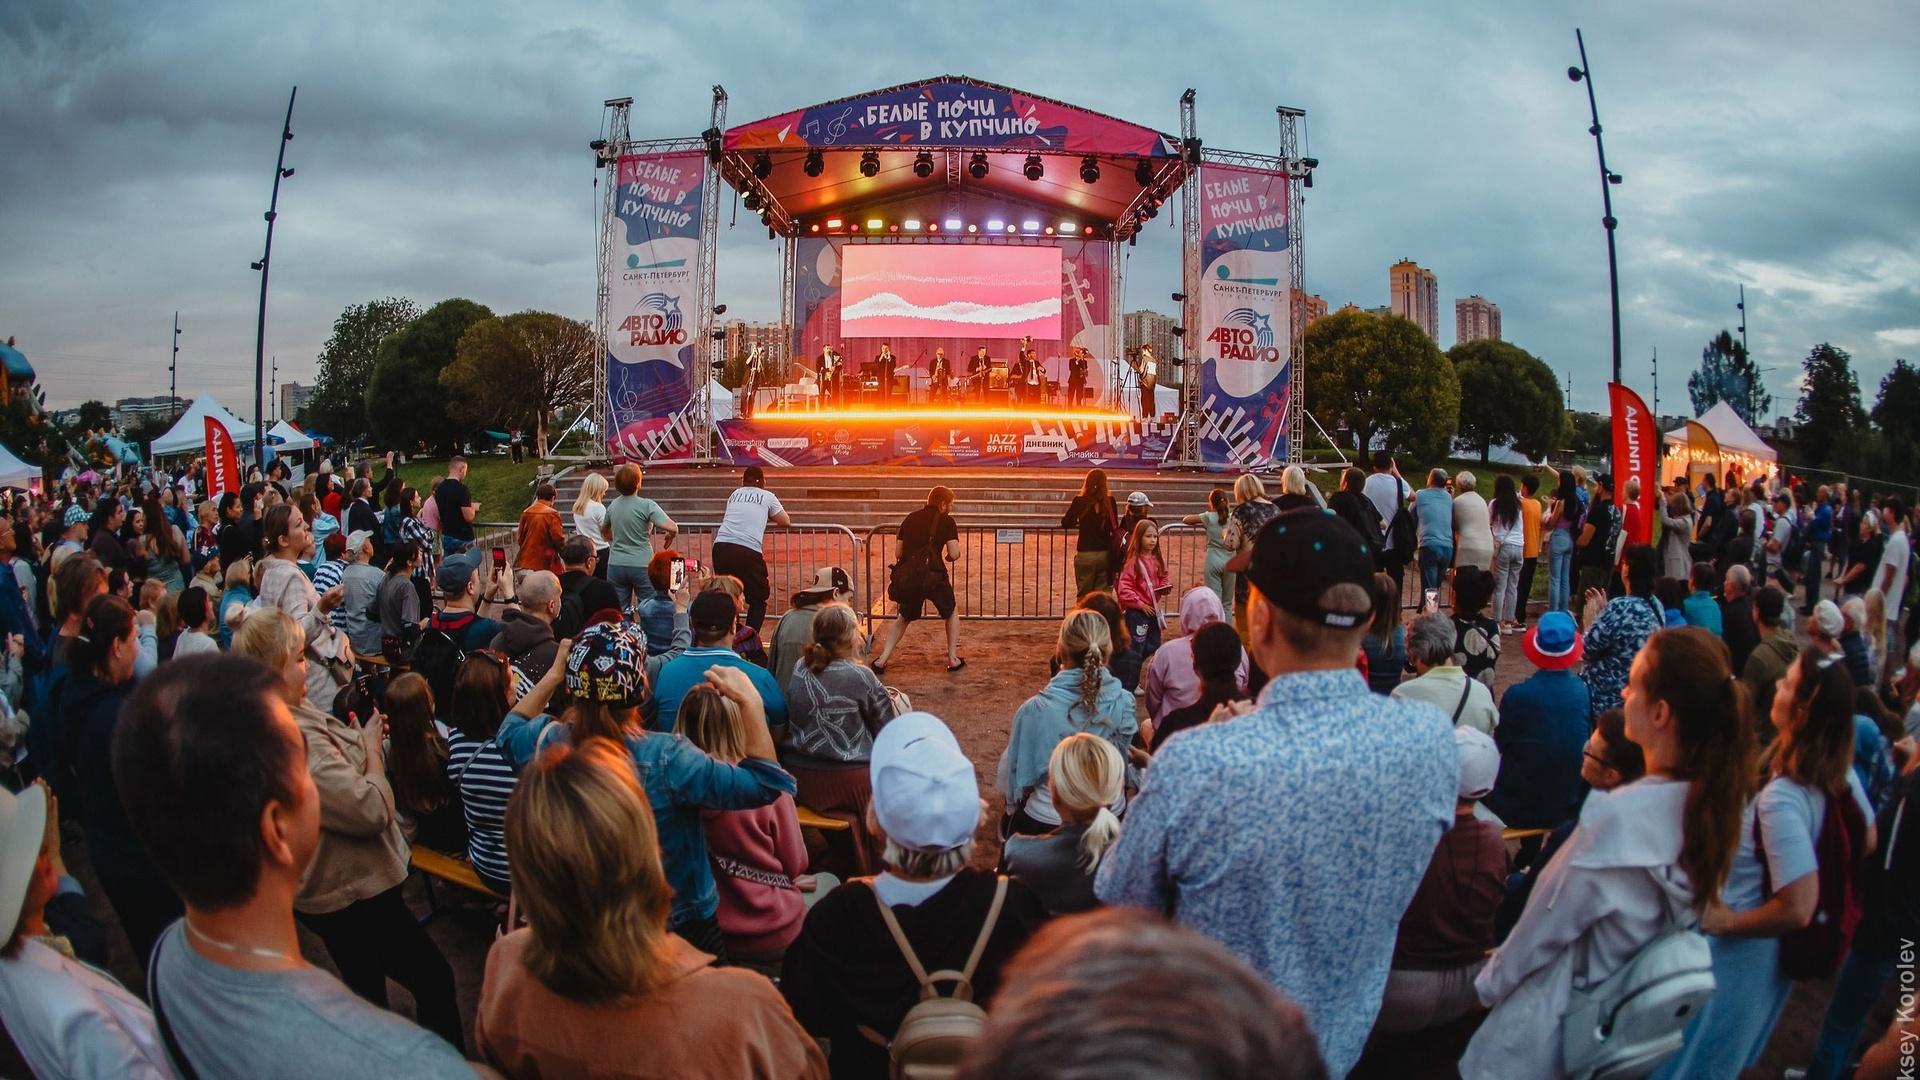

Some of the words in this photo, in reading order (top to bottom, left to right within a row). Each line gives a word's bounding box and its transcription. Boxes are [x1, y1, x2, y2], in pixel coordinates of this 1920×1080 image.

[867, 102, 928, 125] БЕЛЫЕ
[937, 99, 995, 118] НОЧИ
[920, 121, 932, 141] В
[940, 116, 1041, 139] КУПЧИНО
[635, 161, 681, 185] БЕЛЫЕ
[628, 181, 669, 201] НОЧИ
[674, 191, 686, 206] В
[1204, 177, 1250, 200] БЕЛЫЕ
[621, 200, 692, 228] КУПЧИНО
[1211, 198, 1252, 218] НОЧИ
[1258, 195, 1267, 209] В
[1216, 212, 1286, 239] КУПЧИНО
[617, 314, 664, 331] АВТО
[630, 328, 688, 346] РАДИО
[1206, 326, 1254, 343] АВТО
[1219, 343, 1280, 362] РАДИО
[987, 433, 1017, 445] JAZZ
[1025, 440, 1064, 448] ДНЕВНИК
